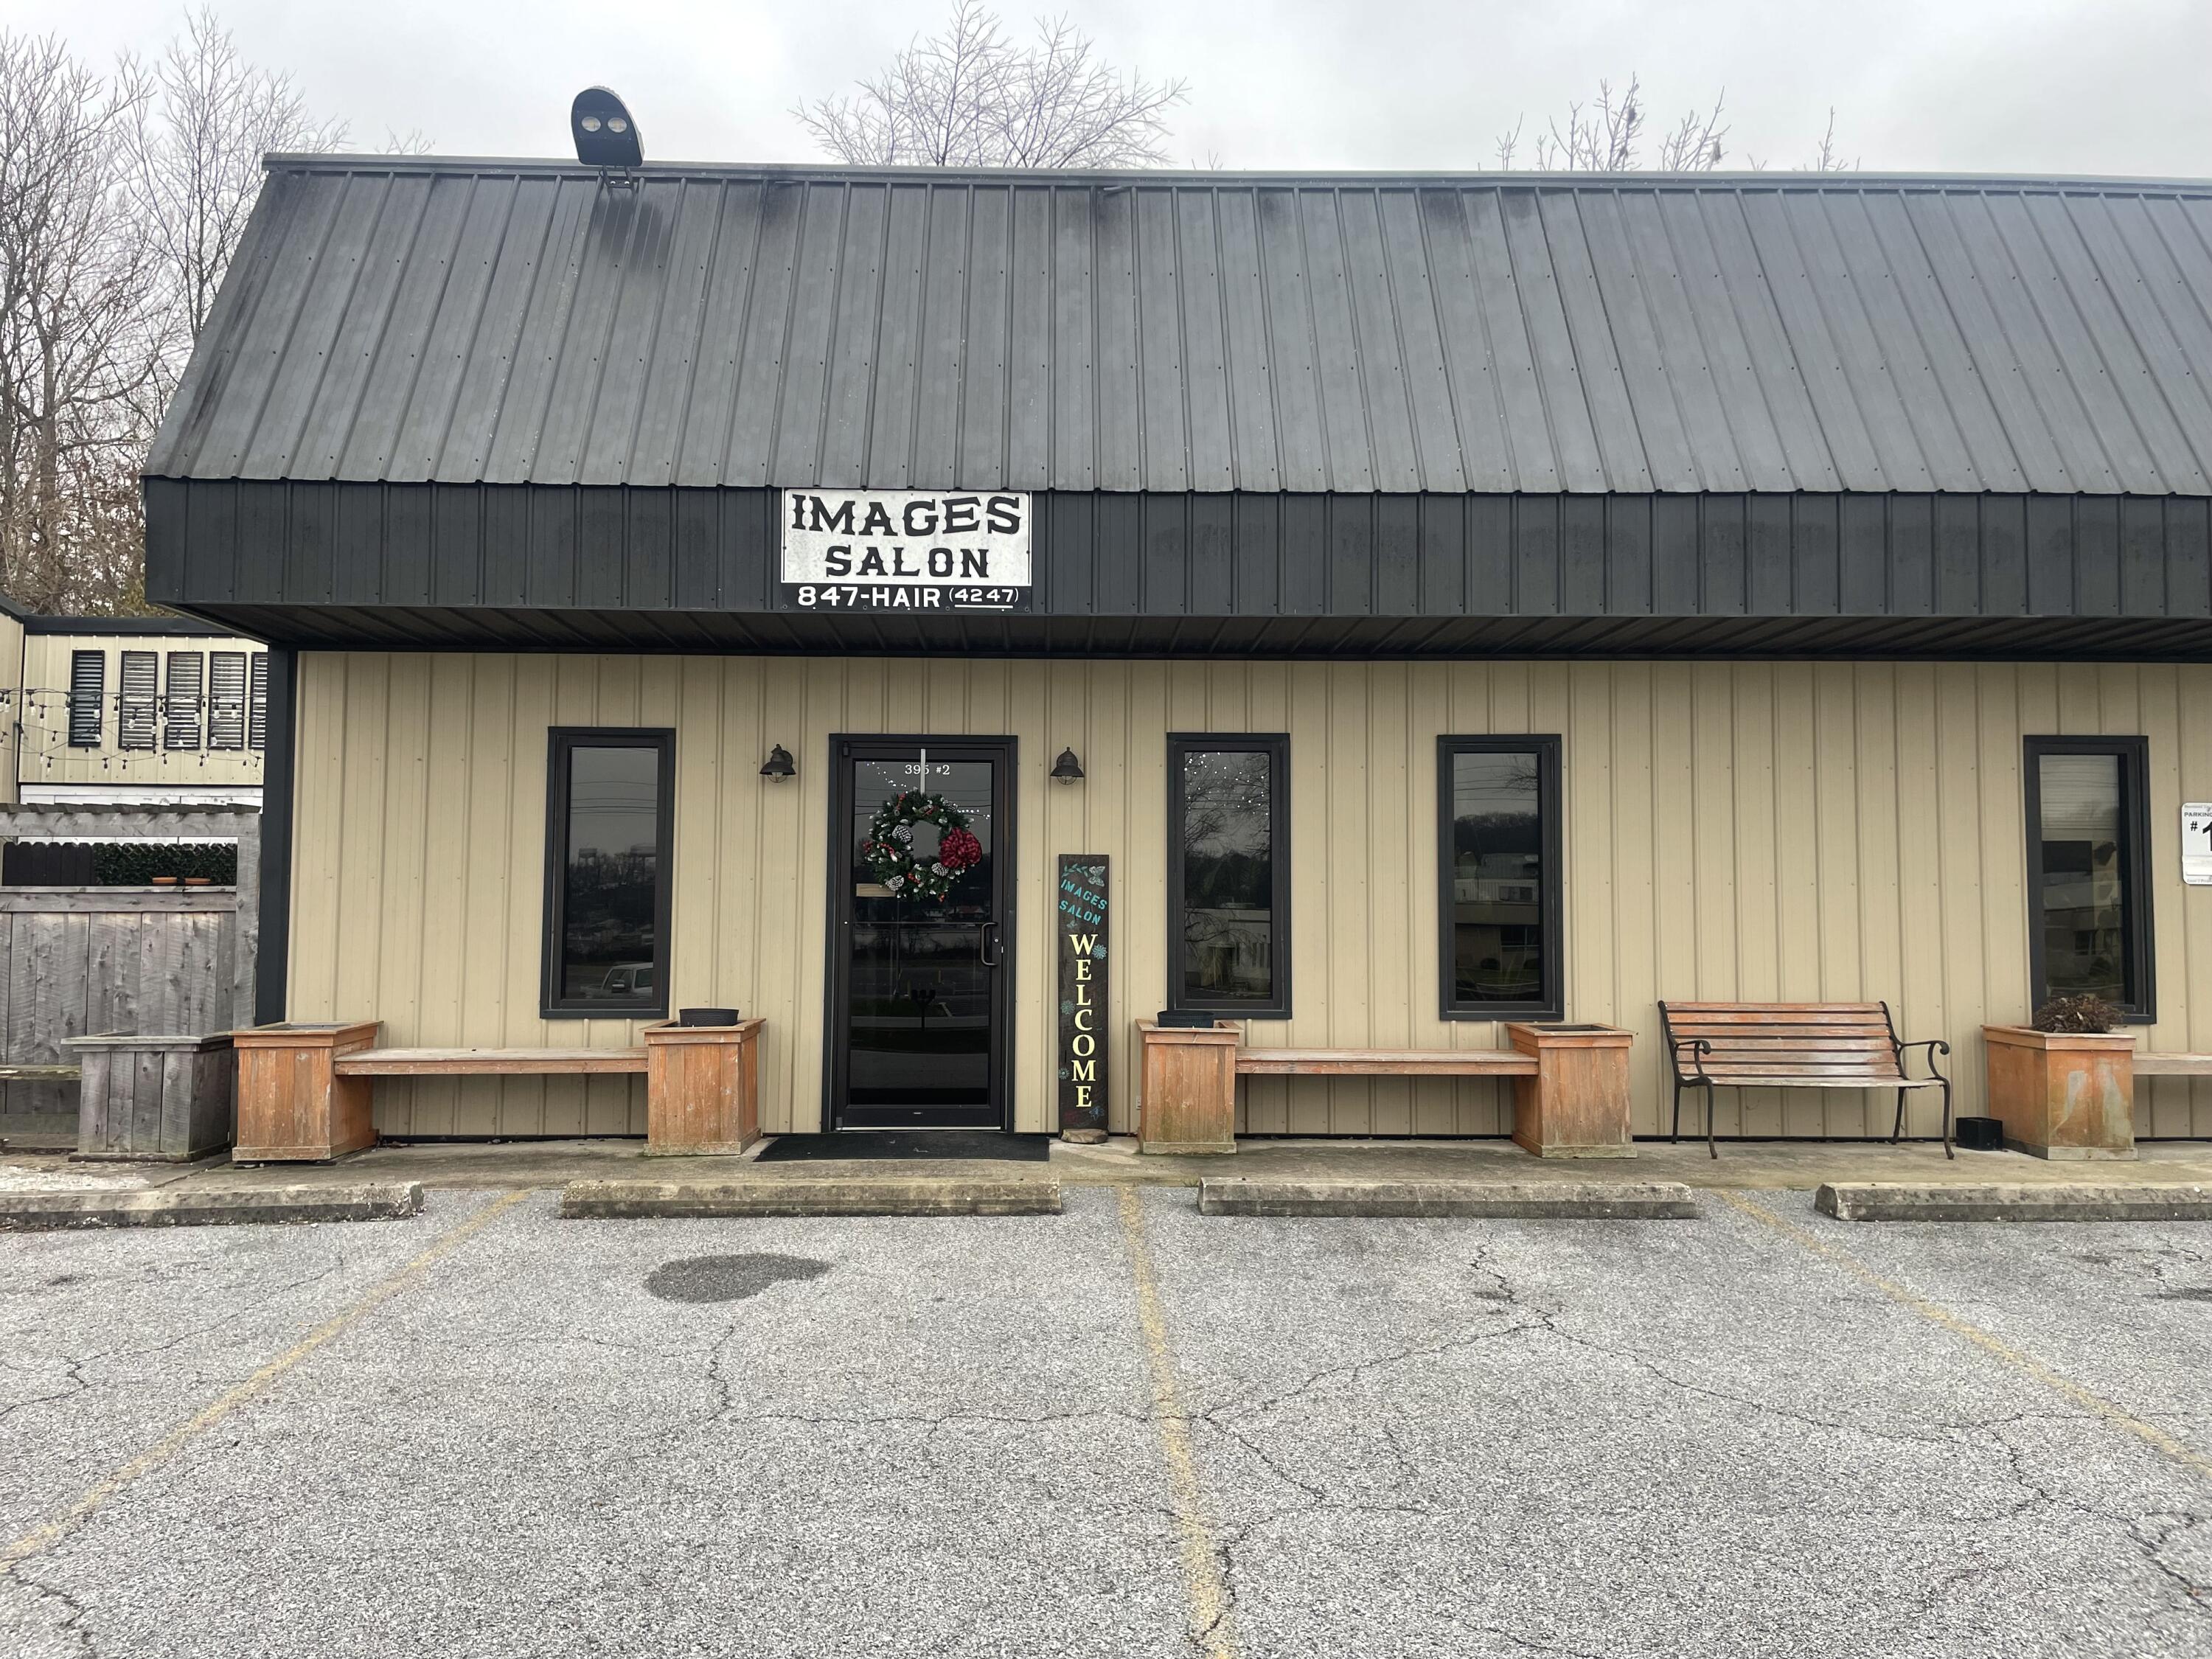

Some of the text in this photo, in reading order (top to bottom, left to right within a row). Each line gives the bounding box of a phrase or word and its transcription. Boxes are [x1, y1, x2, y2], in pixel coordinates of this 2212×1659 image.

[791, 493, 1022, 537] IMAGES
[824, 544, 990, 578] SALON
[798, 586, 1020, 608] 847-HAIR (4247)
[905, 764, 950, 775] 395 #2
[1060, 879, 1107, 910] IMAGES
[1059, 900, 1102, 925] SALON
[1068, 933, 1099, 1107] WELCOME
